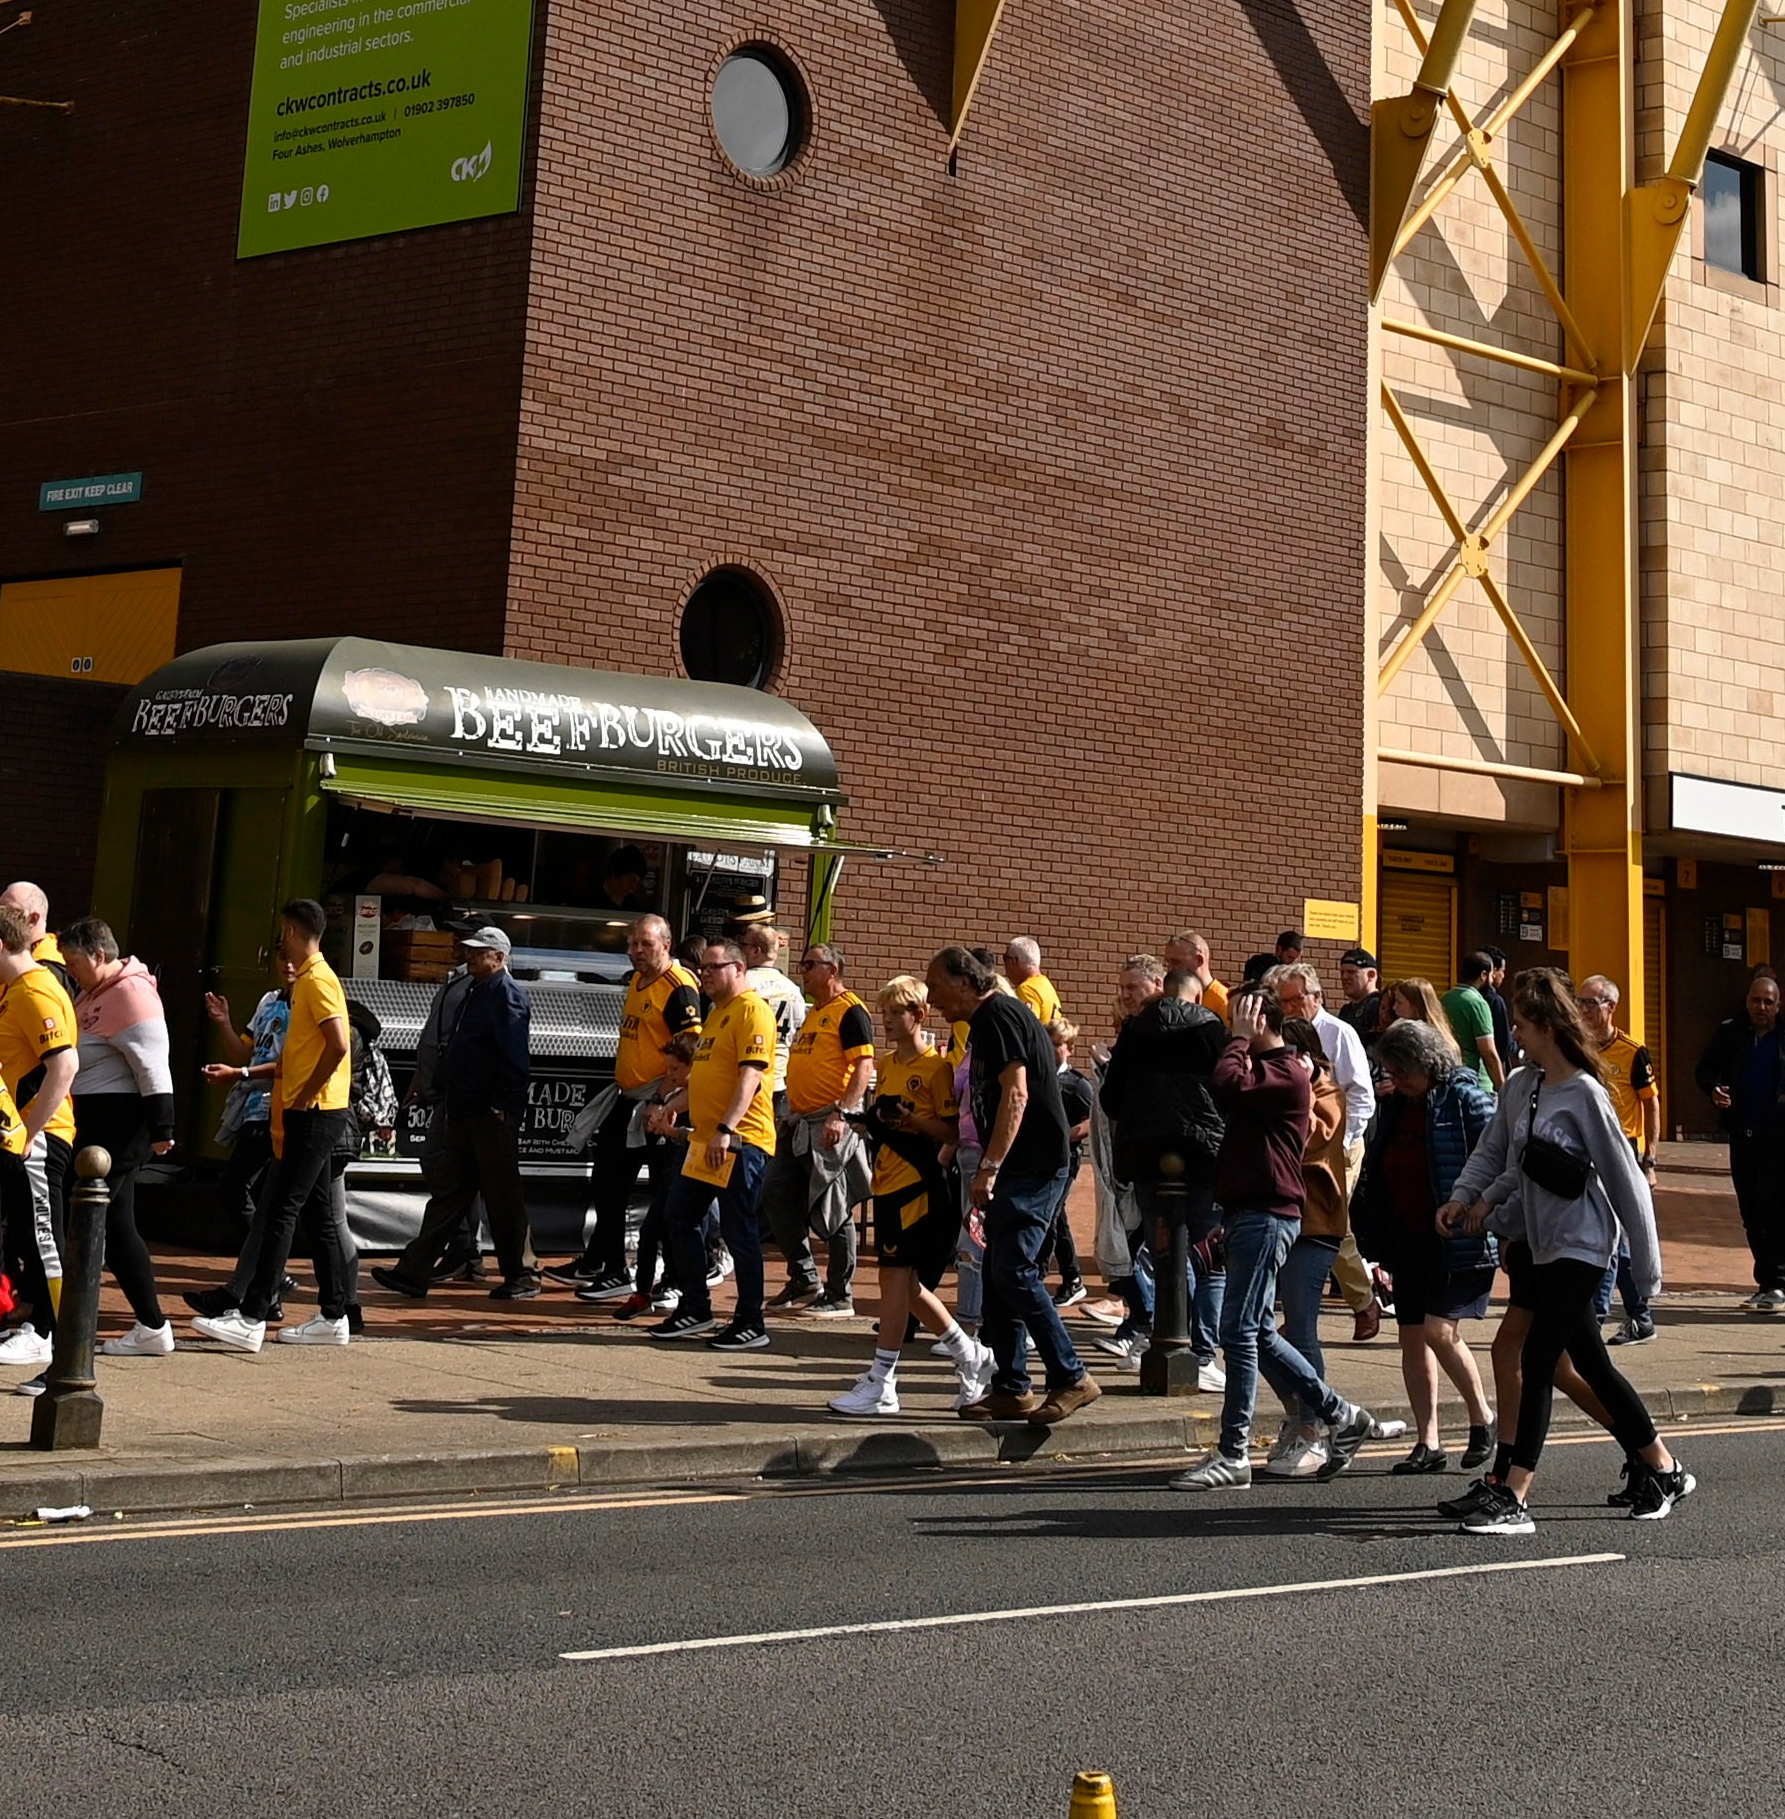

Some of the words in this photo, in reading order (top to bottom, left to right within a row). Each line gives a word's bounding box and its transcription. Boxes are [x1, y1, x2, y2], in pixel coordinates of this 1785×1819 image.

[282, 15, 355, 46] engineering
[358, 11, 370, 28] in
[374, 6, 394, 24] the
[280, 50, 303, 69] and
[306, 38, 362, 64] industrial
[365, 30, 414, 52] sectors.
[276, 68, 432, 117] ckwcontracts.co.uk
[274, 110, 387, 144] info@ckwcontracts.co.uk
[404, 100, 435, 118] 01902
[436, 92, 476, 111] 397850
[272, 147, 293, 162] Four
[295, 142, 326, 159] Ashes,
[328, 126, 402, 152] Wolverhampton
[46, 489, 64, 503] FIRE
[65, 487, 83, 501] EXIT
[84, 484, 106, 499] KEEP
[107, 481, 134, 496] CLEAR
[131, 693, 294, 735] BEEFBURGERS
[484, 685, 582, 708] HANDMADE
[444, 686, 804, 771] BEEFBURGERS
[657, 759, 720, 777] BRITISH
[727, 766, 801, 785] PRODUCE
